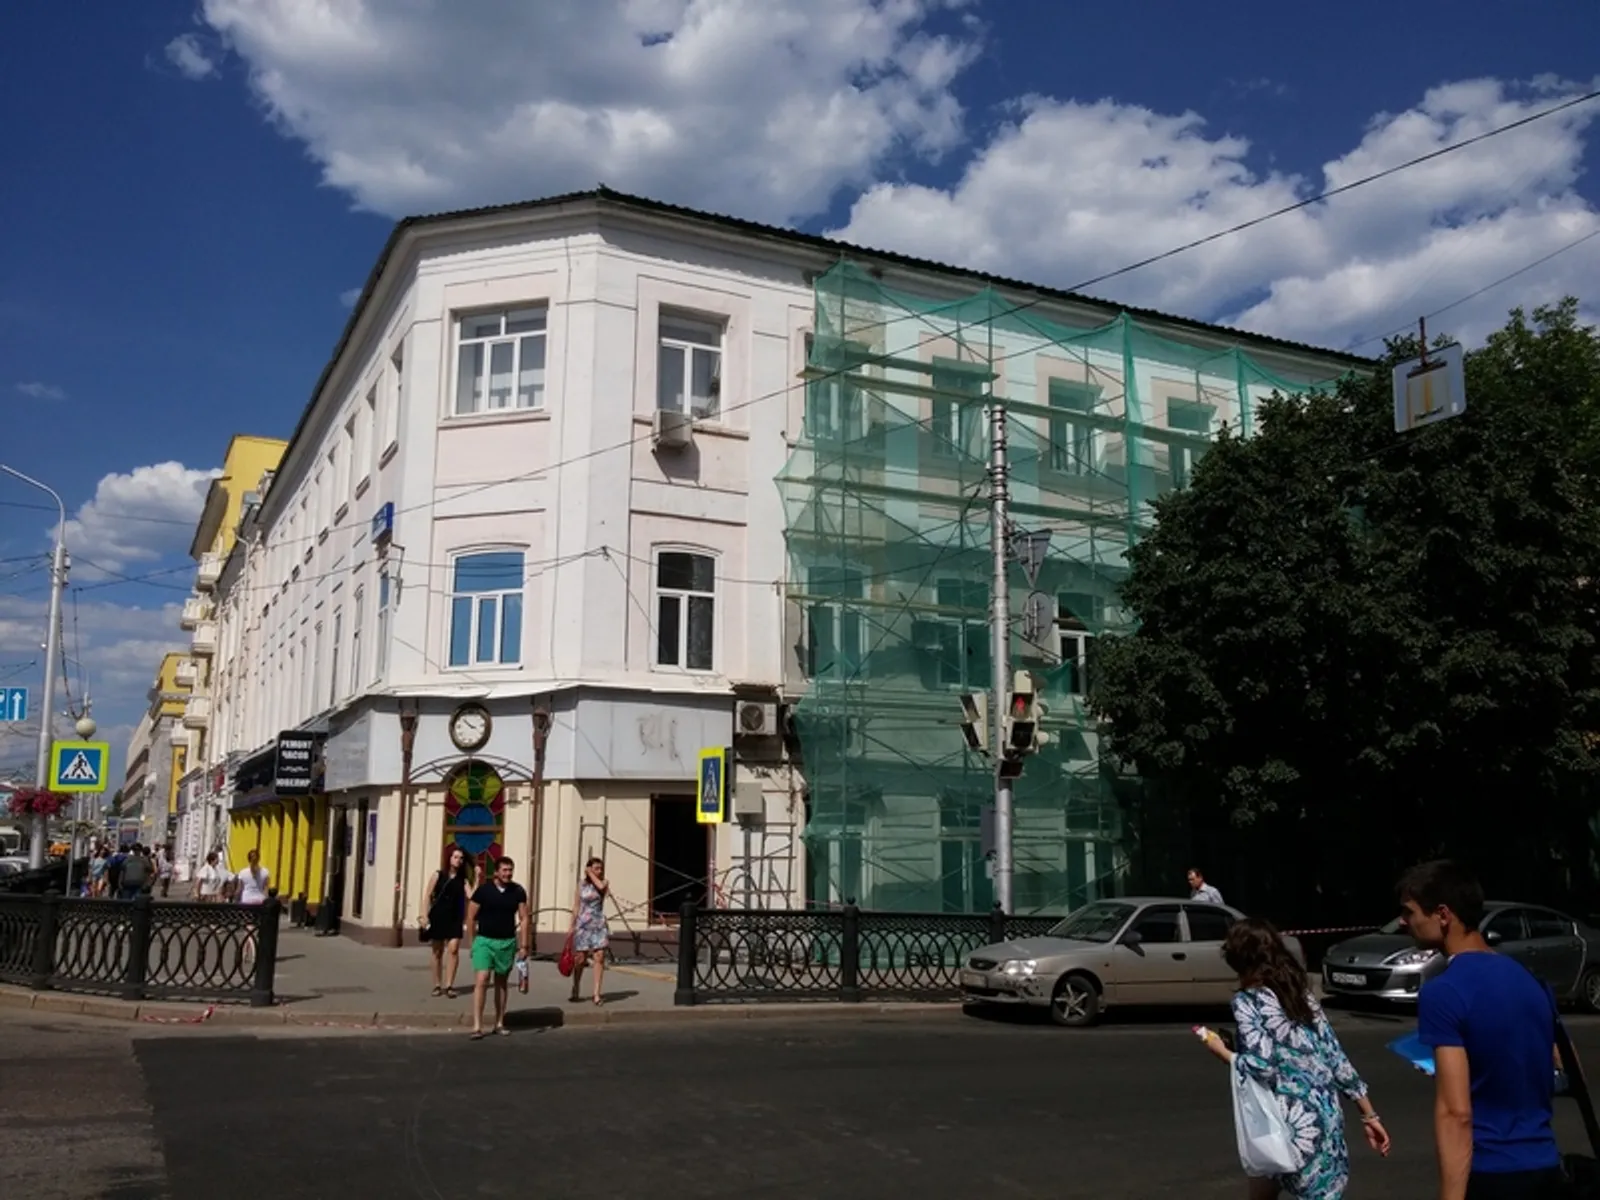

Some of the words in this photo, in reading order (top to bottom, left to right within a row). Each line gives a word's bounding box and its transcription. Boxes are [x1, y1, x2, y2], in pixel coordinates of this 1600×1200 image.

[280, 740, 313, 749] РЕМОНТ
[282, 751, 309, 760] ЧАСОВ
[276, 778, 311, 787] ЮВЕЛИР
